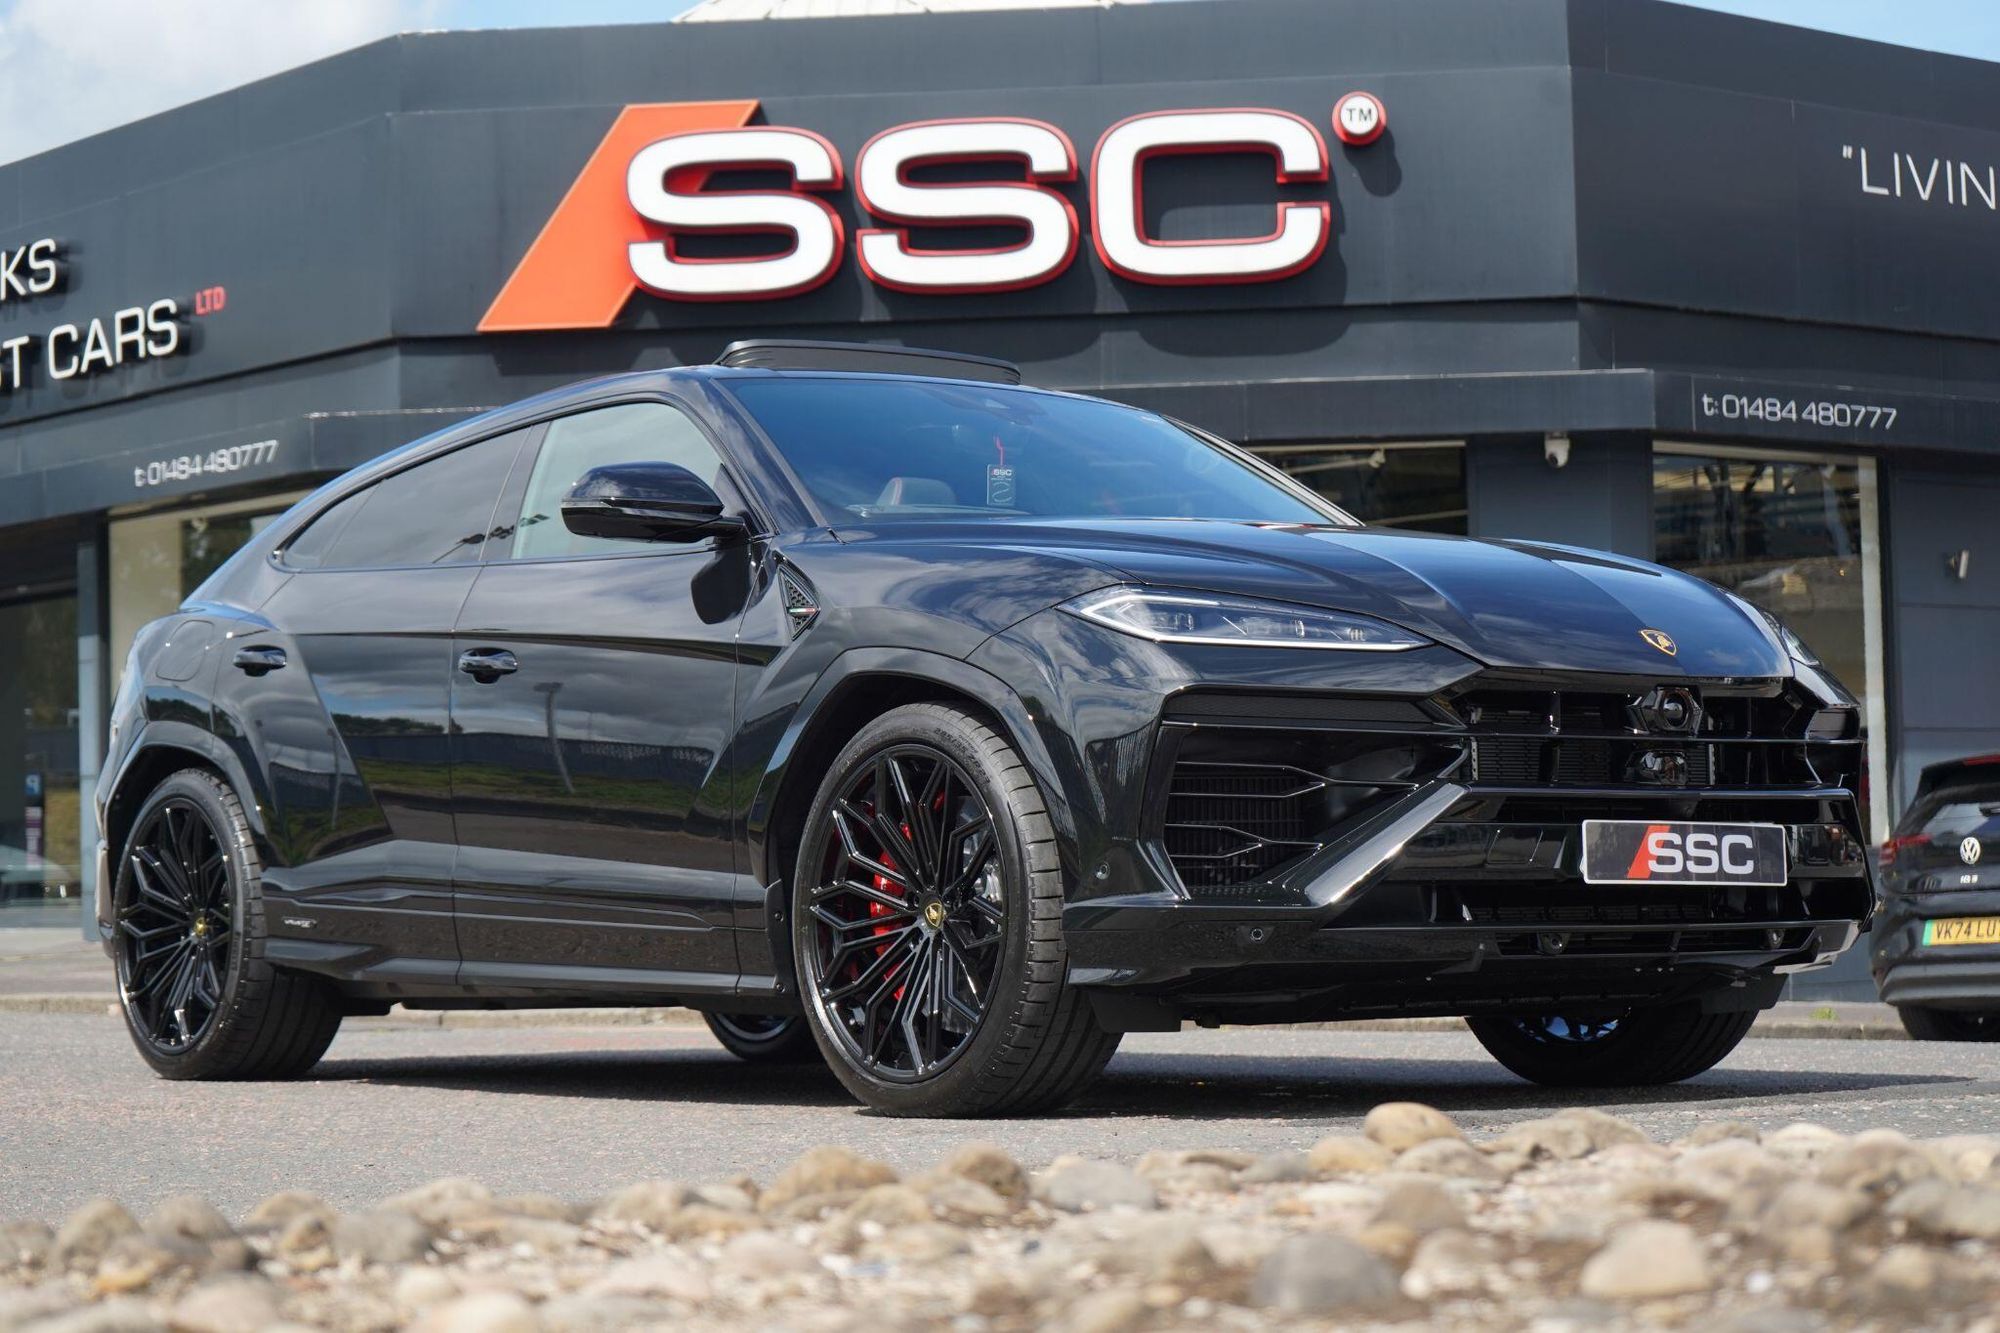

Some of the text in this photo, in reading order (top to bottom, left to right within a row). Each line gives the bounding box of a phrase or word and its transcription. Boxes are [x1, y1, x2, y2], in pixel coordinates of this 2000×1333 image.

[1346, 108, 1372, 122] TM
[626, 107, 1330, 302] SSC
[0, 238, 57, 301] KS
[0, 286, 227, 389] T CARS LTD
[1801, 403, 1897, 430] 480777
[203, 439, 279, 473] 480777
[1647, 832, 1755, 875] SSC
[1935, 918, 2000, 940] VK74 LU
